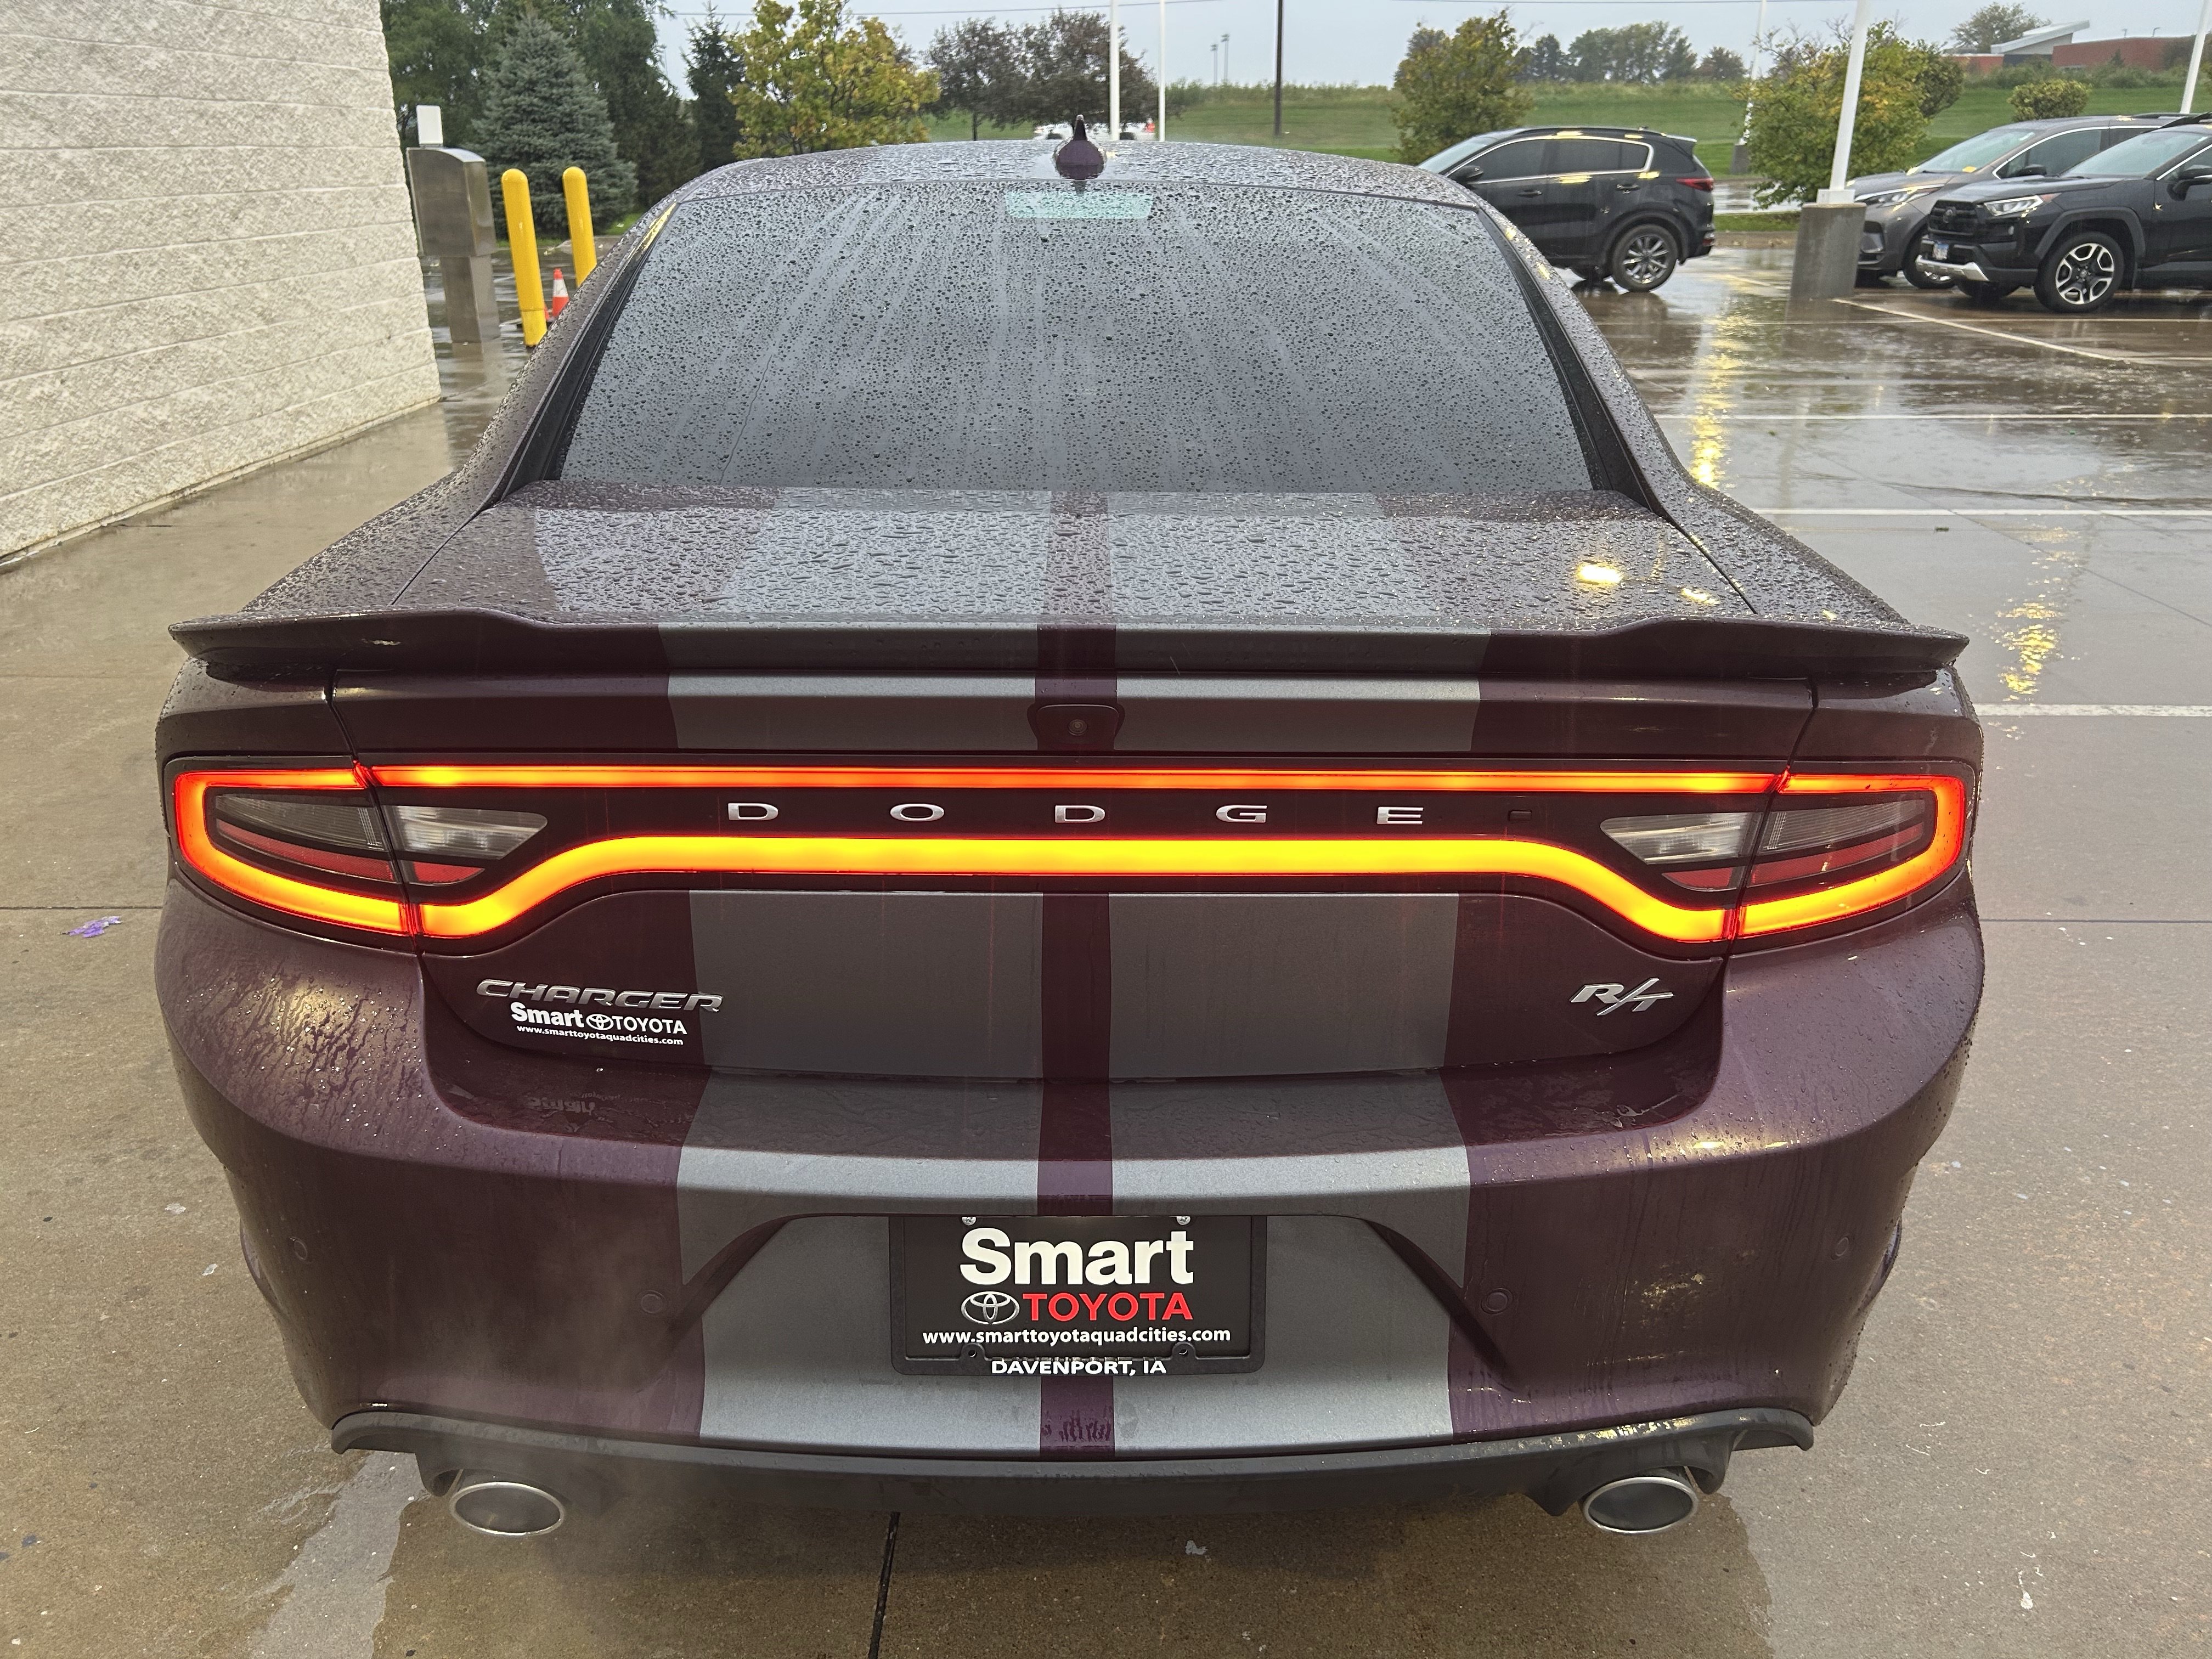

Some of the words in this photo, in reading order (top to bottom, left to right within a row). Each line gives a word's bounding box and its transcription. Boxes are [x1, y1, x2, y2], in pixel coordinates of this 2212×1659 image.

[728, 802, 1424, 825] DODGE
[476, 979, 724, 1012] CHARGER
[510, 1002, 585, 1028] Smart
[612, 1015, 688, 1035] TOYOTA
[516, 1025, 684, 1045] www.smarttoyotaquadcities.com
[960, 1227, 1194, 1285] Smart
[1023, 1293, 1193, 1322] TOYOTA
[922, 1327, 1231, 1346] www.smarttoyotaquadcities.com
[991, 1361, 1136, 1376] DAVENPORT,
[1143, 1361, 1167, 1374] IA
